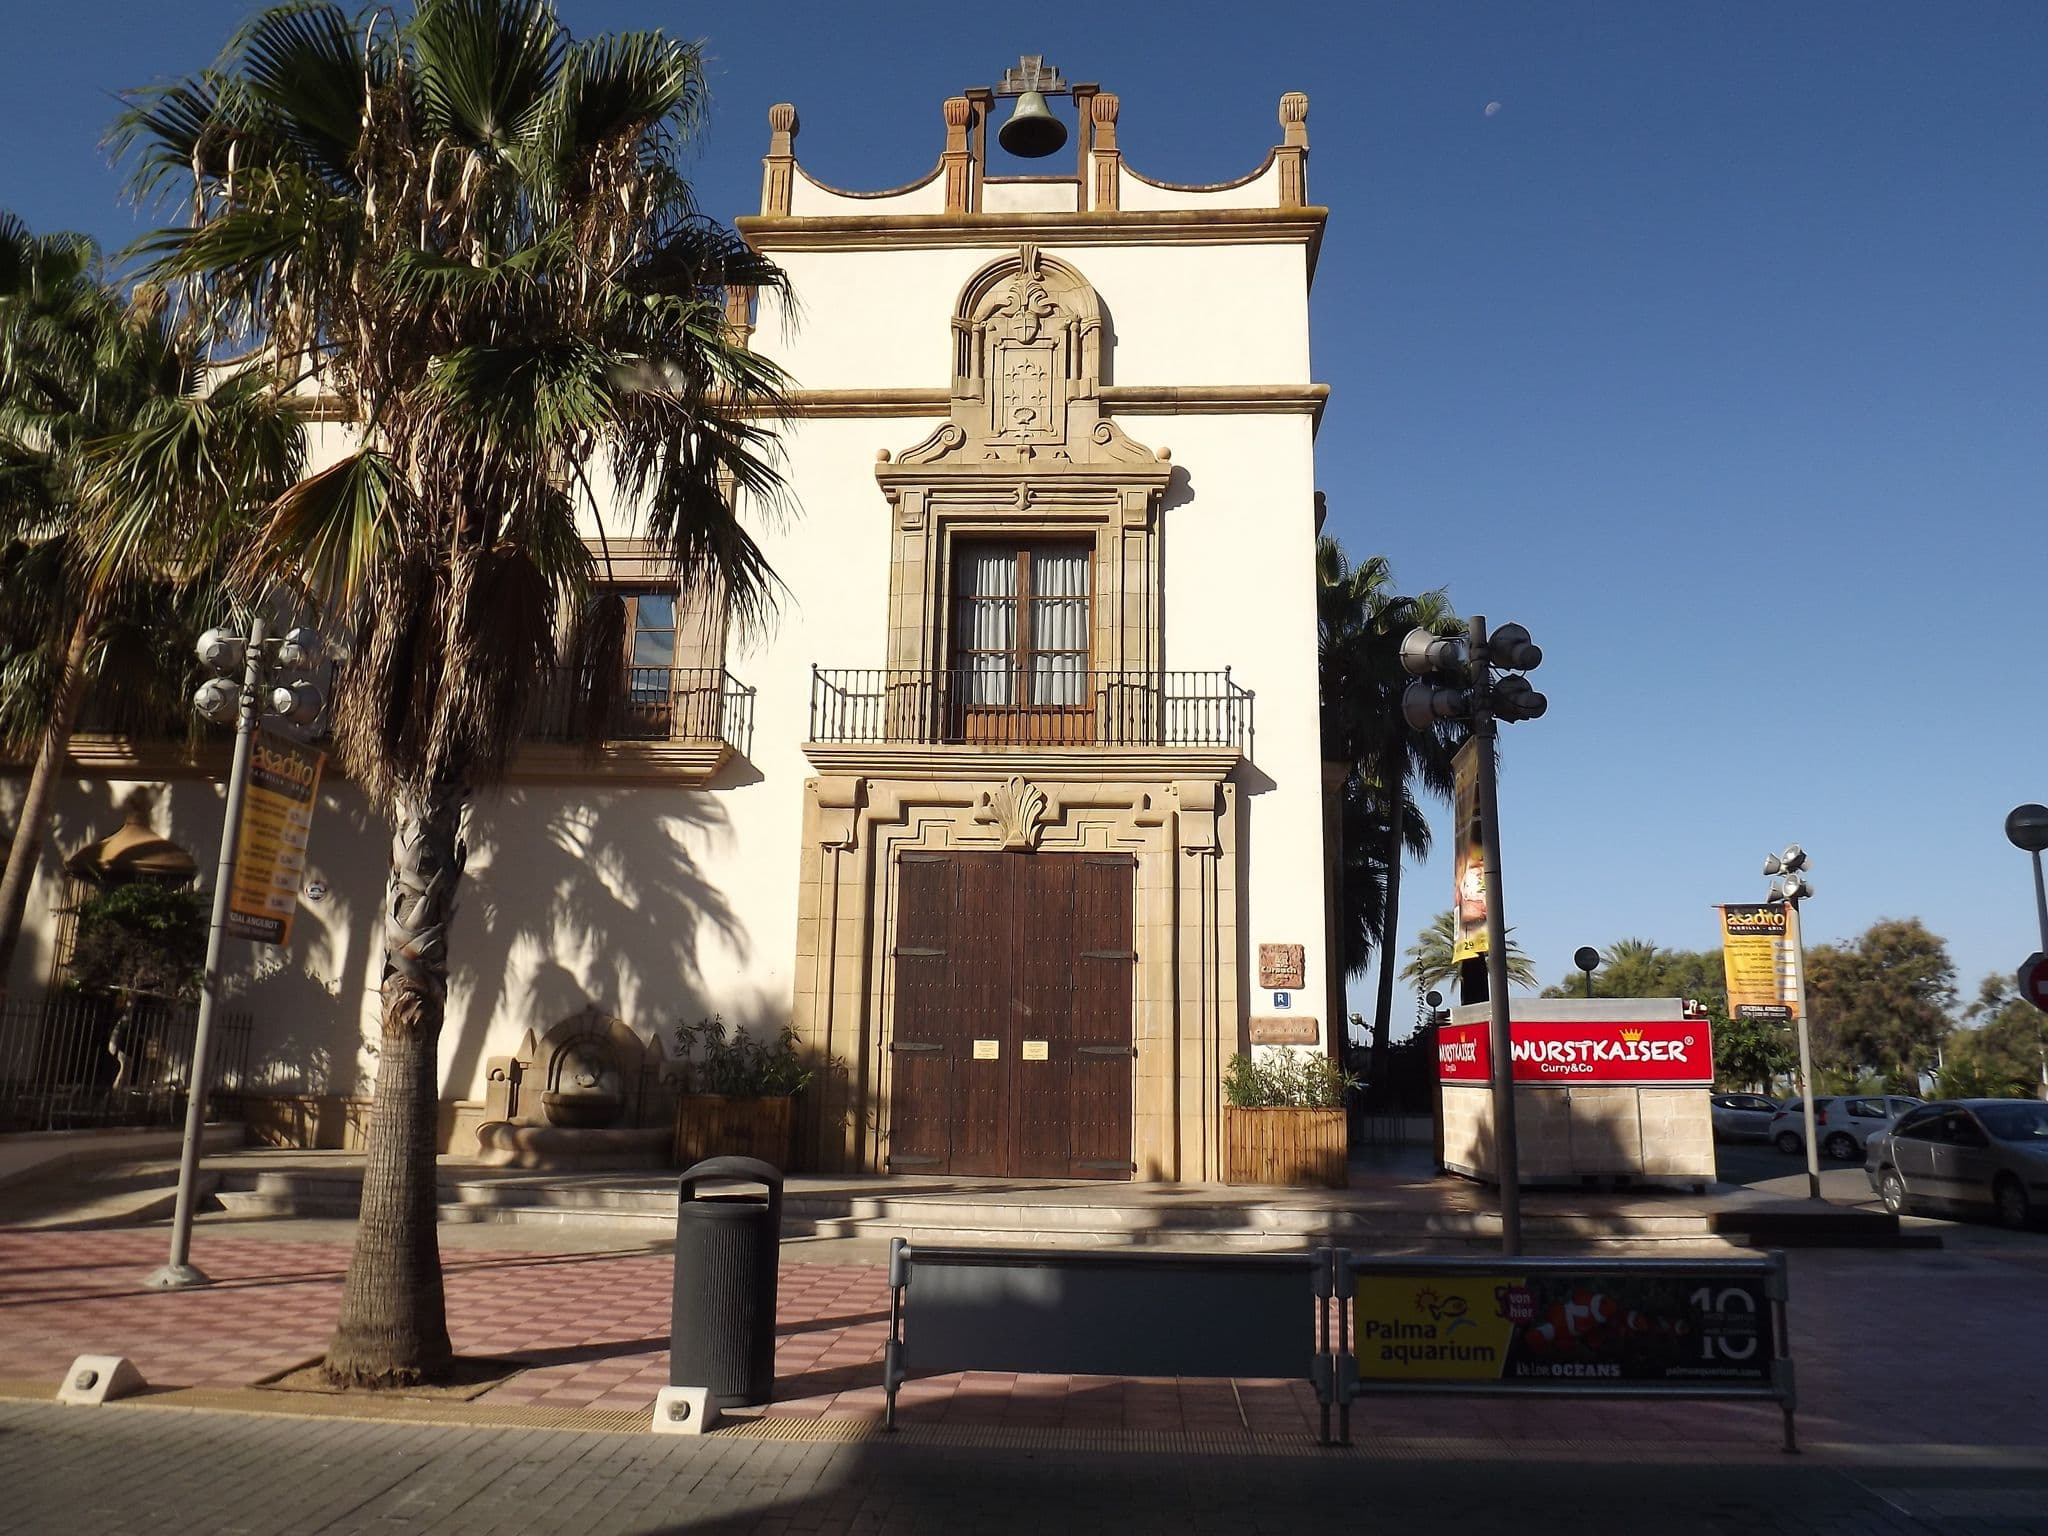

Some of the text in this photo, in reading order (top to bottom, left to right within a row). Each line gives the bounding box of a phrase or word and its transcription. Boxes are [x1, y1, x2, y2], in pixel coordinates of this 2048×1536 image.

[252, 747, 314, 788] asadito
[1727, 908, 1785, 926] asadito
[1277, 993, 1285, 1003] R
[1541, 1063, 1594, 1074] Curry&Co
[1510, 1293, 1531, 1304] von
[1510, 1305, 1532, 1318] hier
[1366, 1318, 1437, 1339] Palma
[1380, 1340, 1496, 1365] aquarium
[1551, 1363, 1621, 1377] OCEANS
